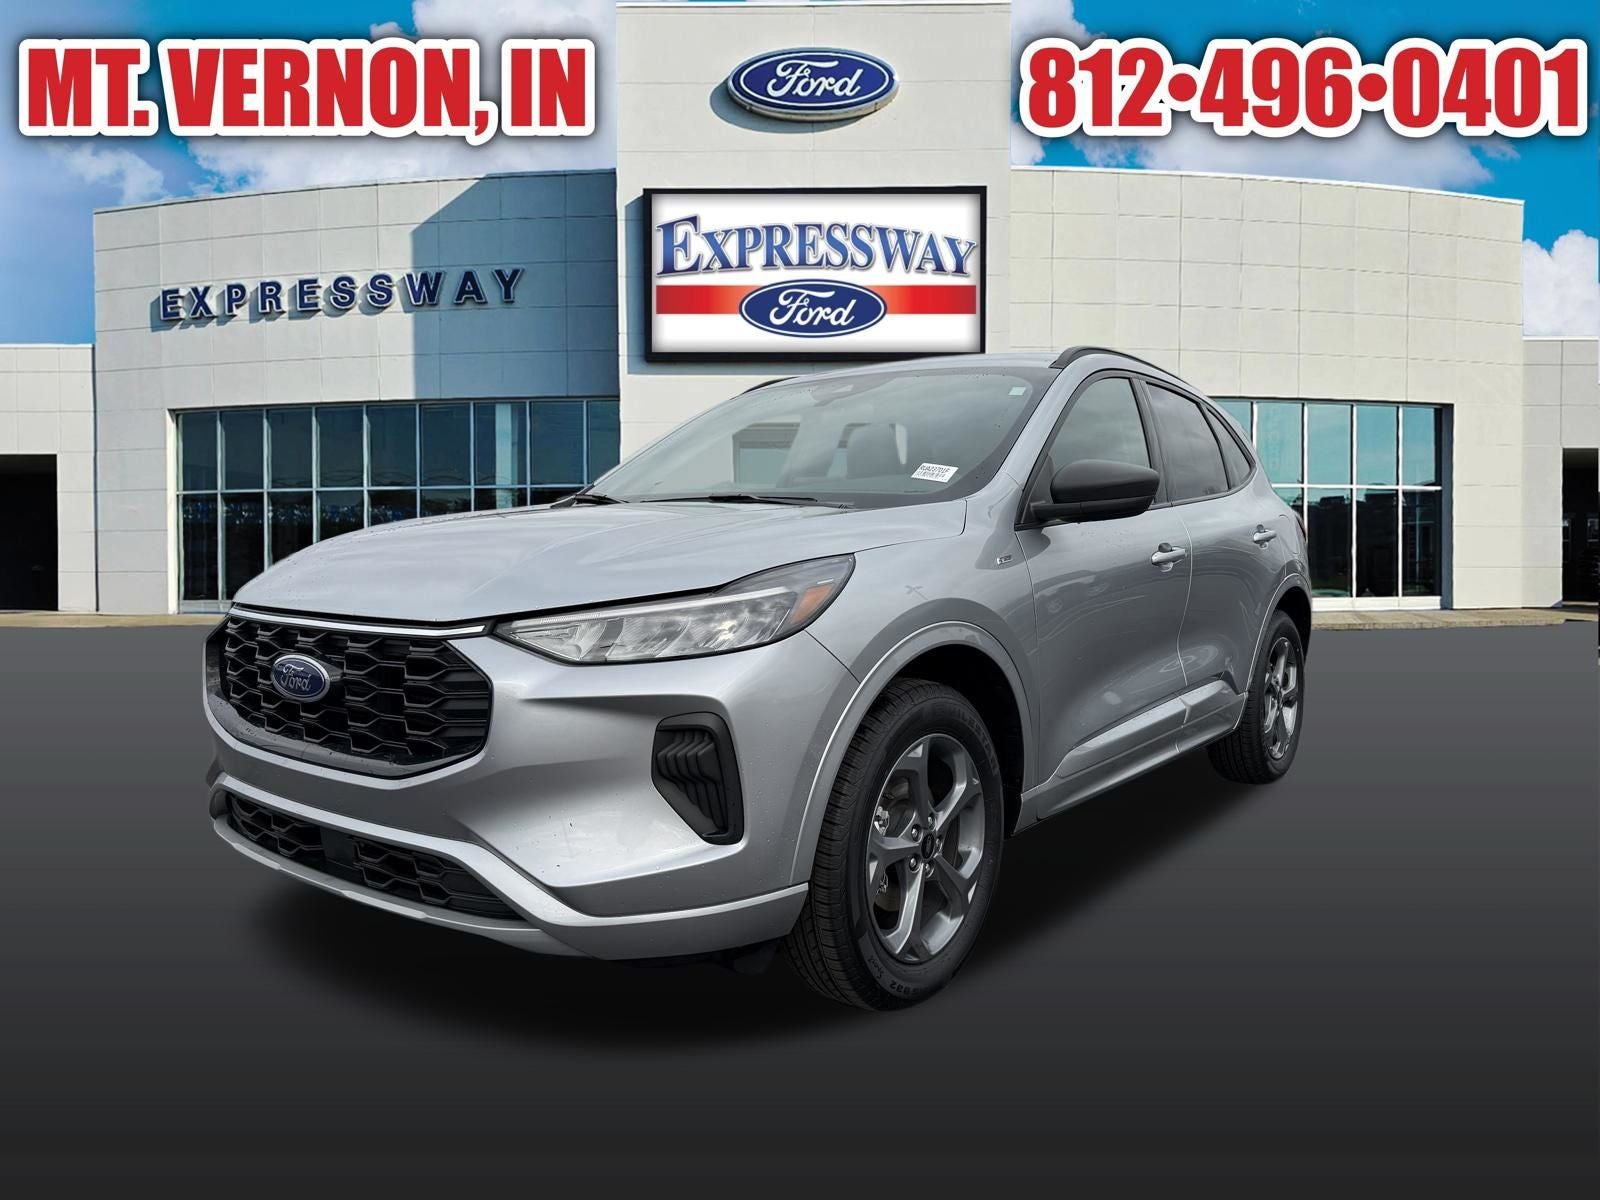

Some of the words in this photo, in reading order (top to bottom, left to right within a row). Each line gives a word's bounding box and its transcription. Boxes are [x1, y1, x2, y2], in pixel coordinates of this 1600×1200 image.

[767, 59, 863, 97] Ford
[656, 213, 977, 278] EXPRESSWAY
[159, 268, 526, 322] EXPRESSWAY
[769, 289, 857, 327] Ford
[280, 663, 313, 692] Ford
